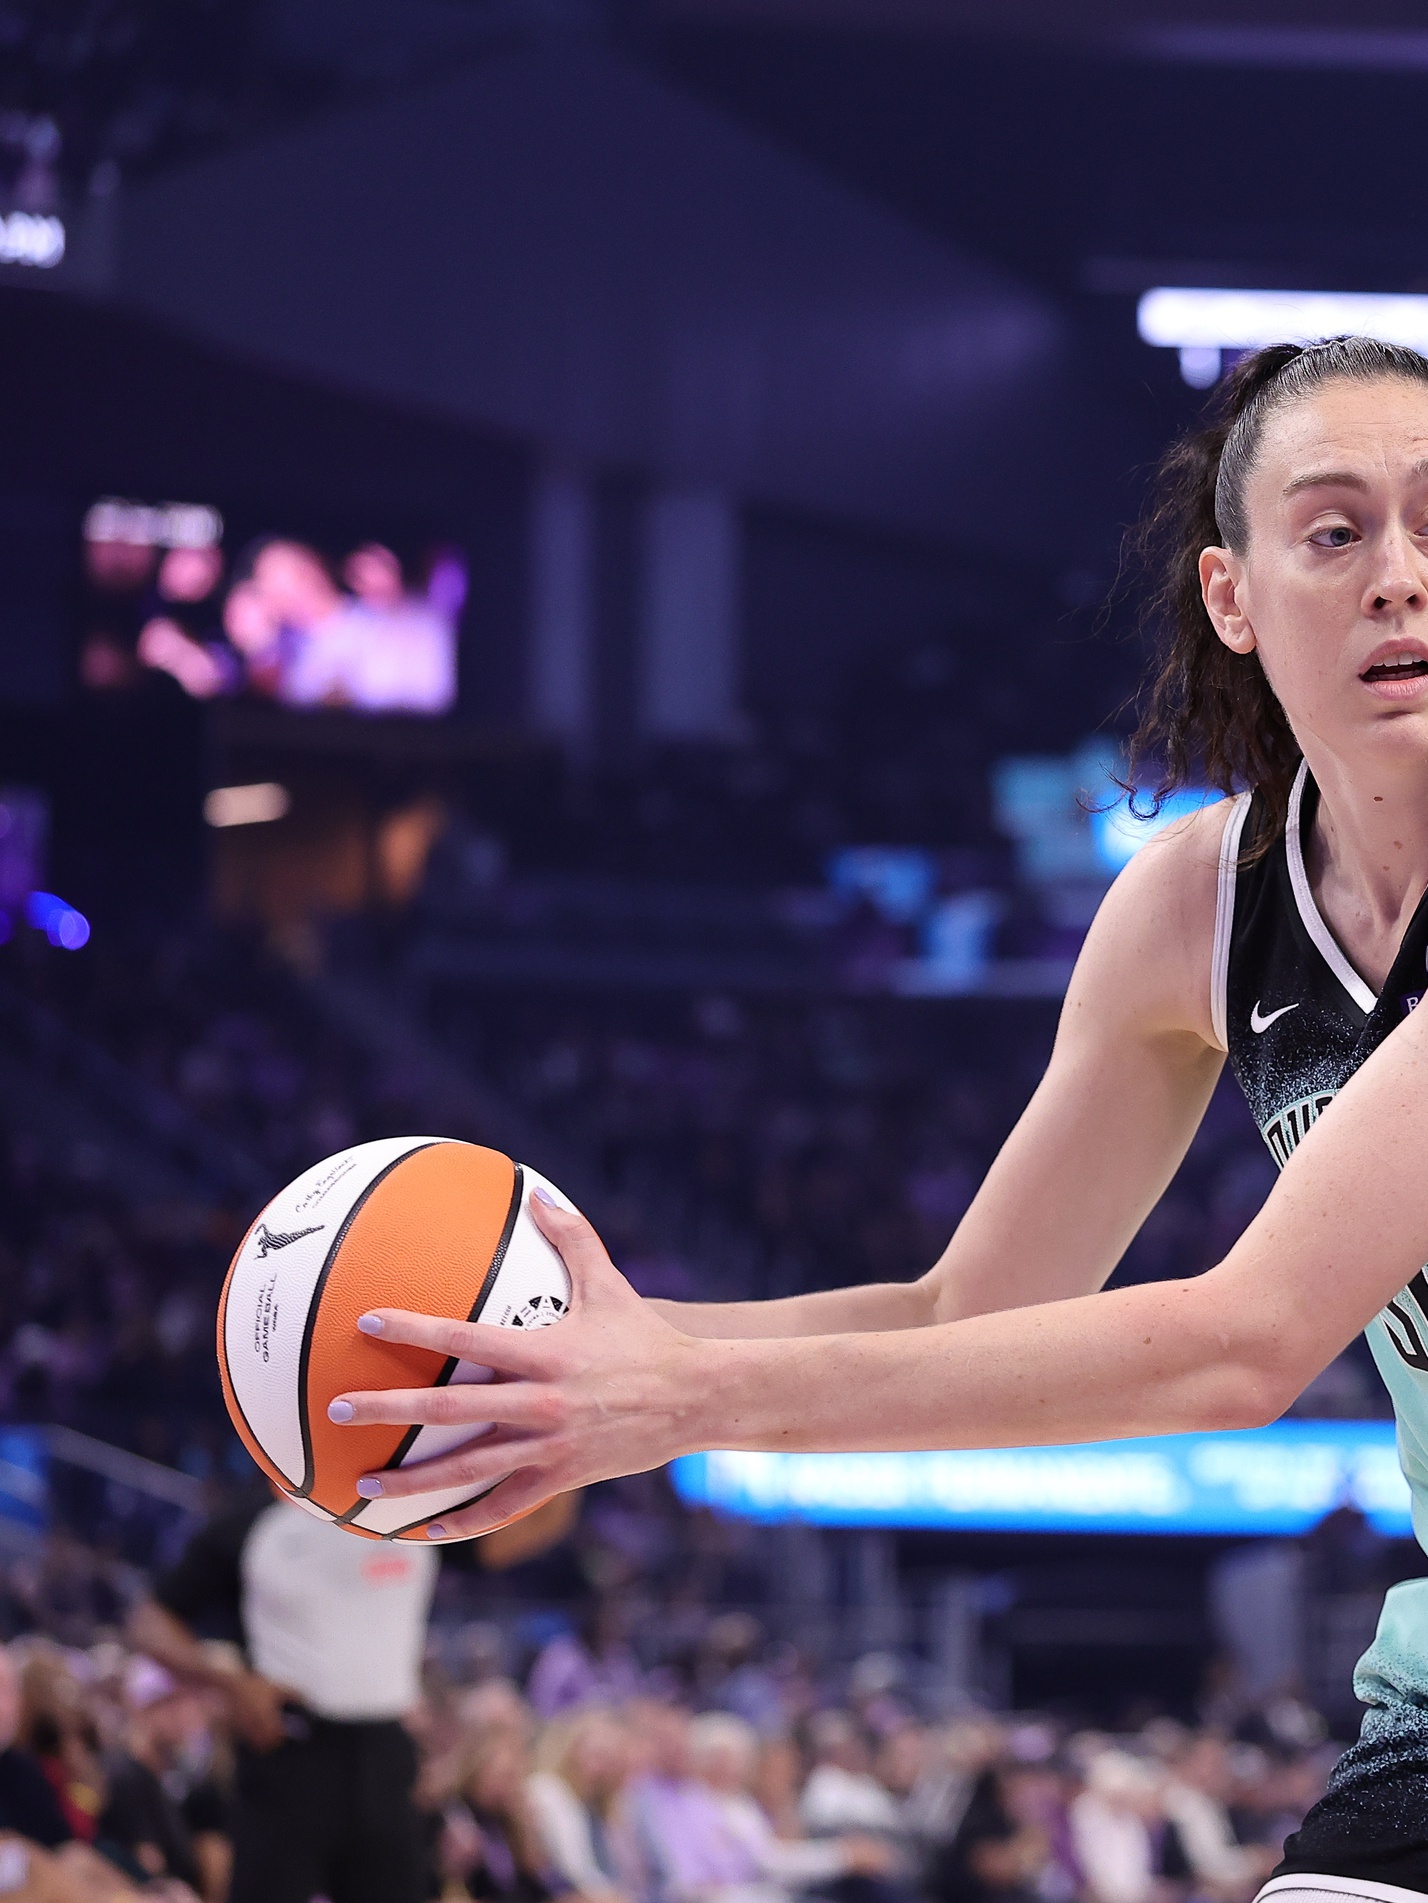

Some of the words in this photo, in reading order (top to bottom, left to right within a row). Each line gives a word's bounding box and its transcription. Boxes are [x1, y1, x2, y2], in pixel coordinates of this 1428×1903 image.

[264, 1272, 278, 1314] BALL
[254, 1283, 267, 1353] OFFICIAL
[262, 1314, 270, 1363] GAME
